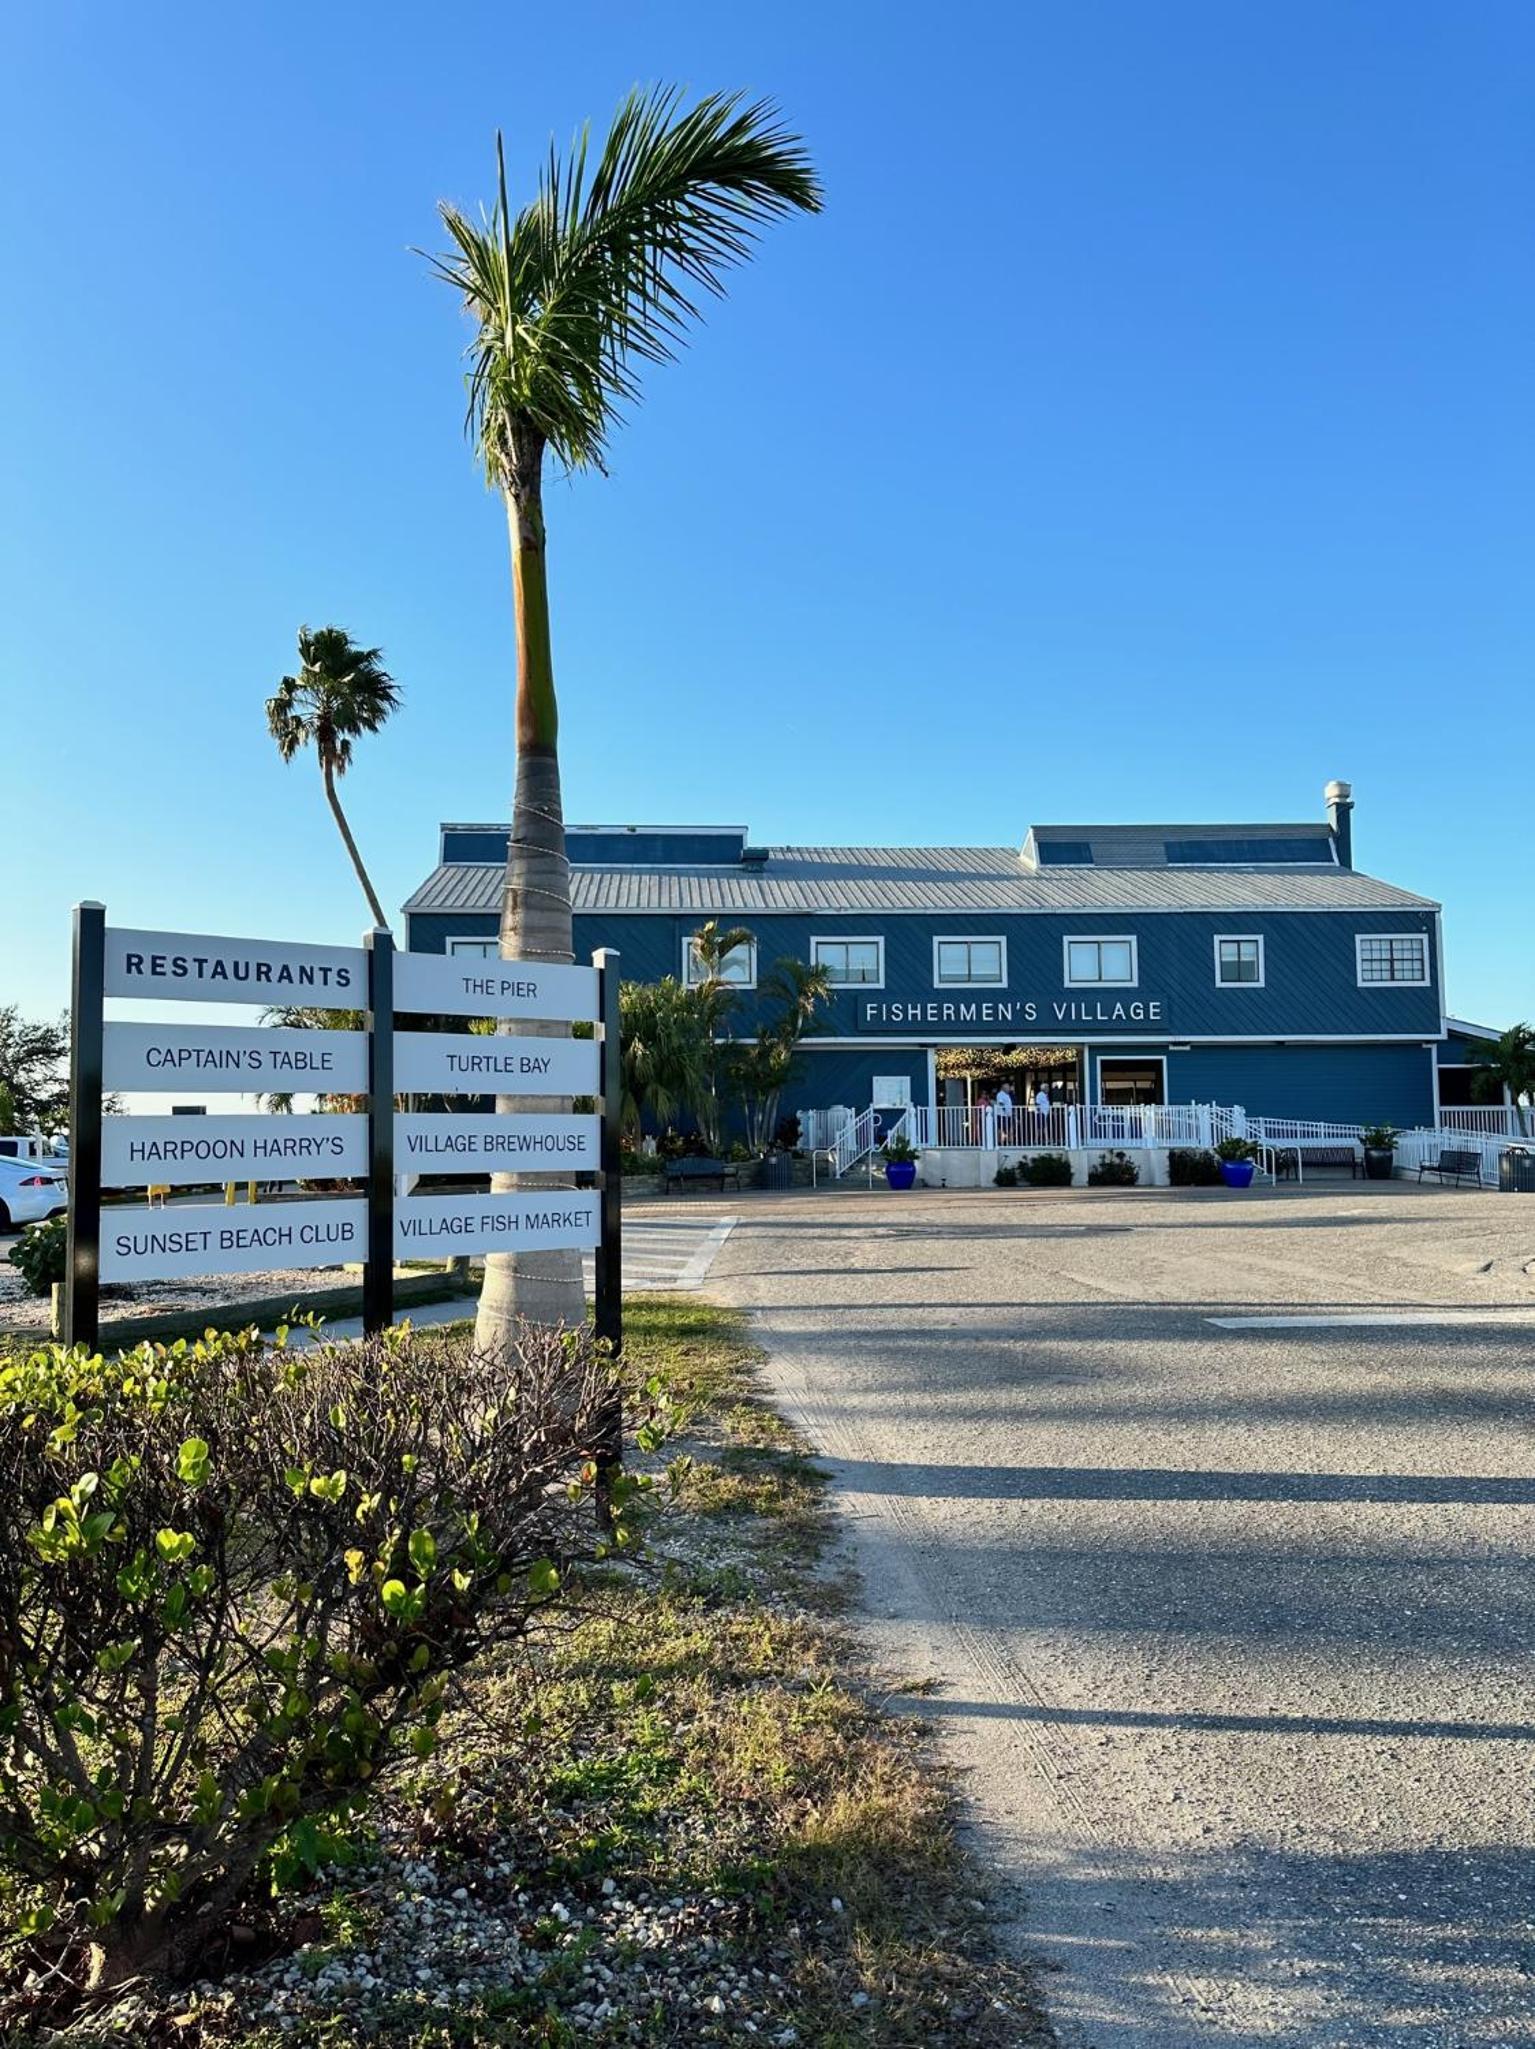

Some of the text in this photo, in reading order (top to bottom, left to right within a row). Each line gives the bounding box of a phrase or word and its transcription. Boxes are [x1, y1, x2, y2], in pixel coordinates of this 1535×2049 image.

[127, 954, 350, 987] RESTAURANTS
[463, 978, 537, 997] THE PIER
[867, 1002, 1160, 1021] FISHERMEN'S VILLAGE
[146, 1048, 332, 1070] CAPTAIN'S TABLE
[446, 1055, 550, 1073] TURTLE BAY
[131, 1137, 343, 1161] HARPOON HARRY'S
[407, 1135, 586, 1152] VILLAGE BREWHOUSE
[400, 1211, 592, 1236] VILLAGE FISH MARKET
[116, 1223, 354, 1256] SUNSET BEACH CLUB
